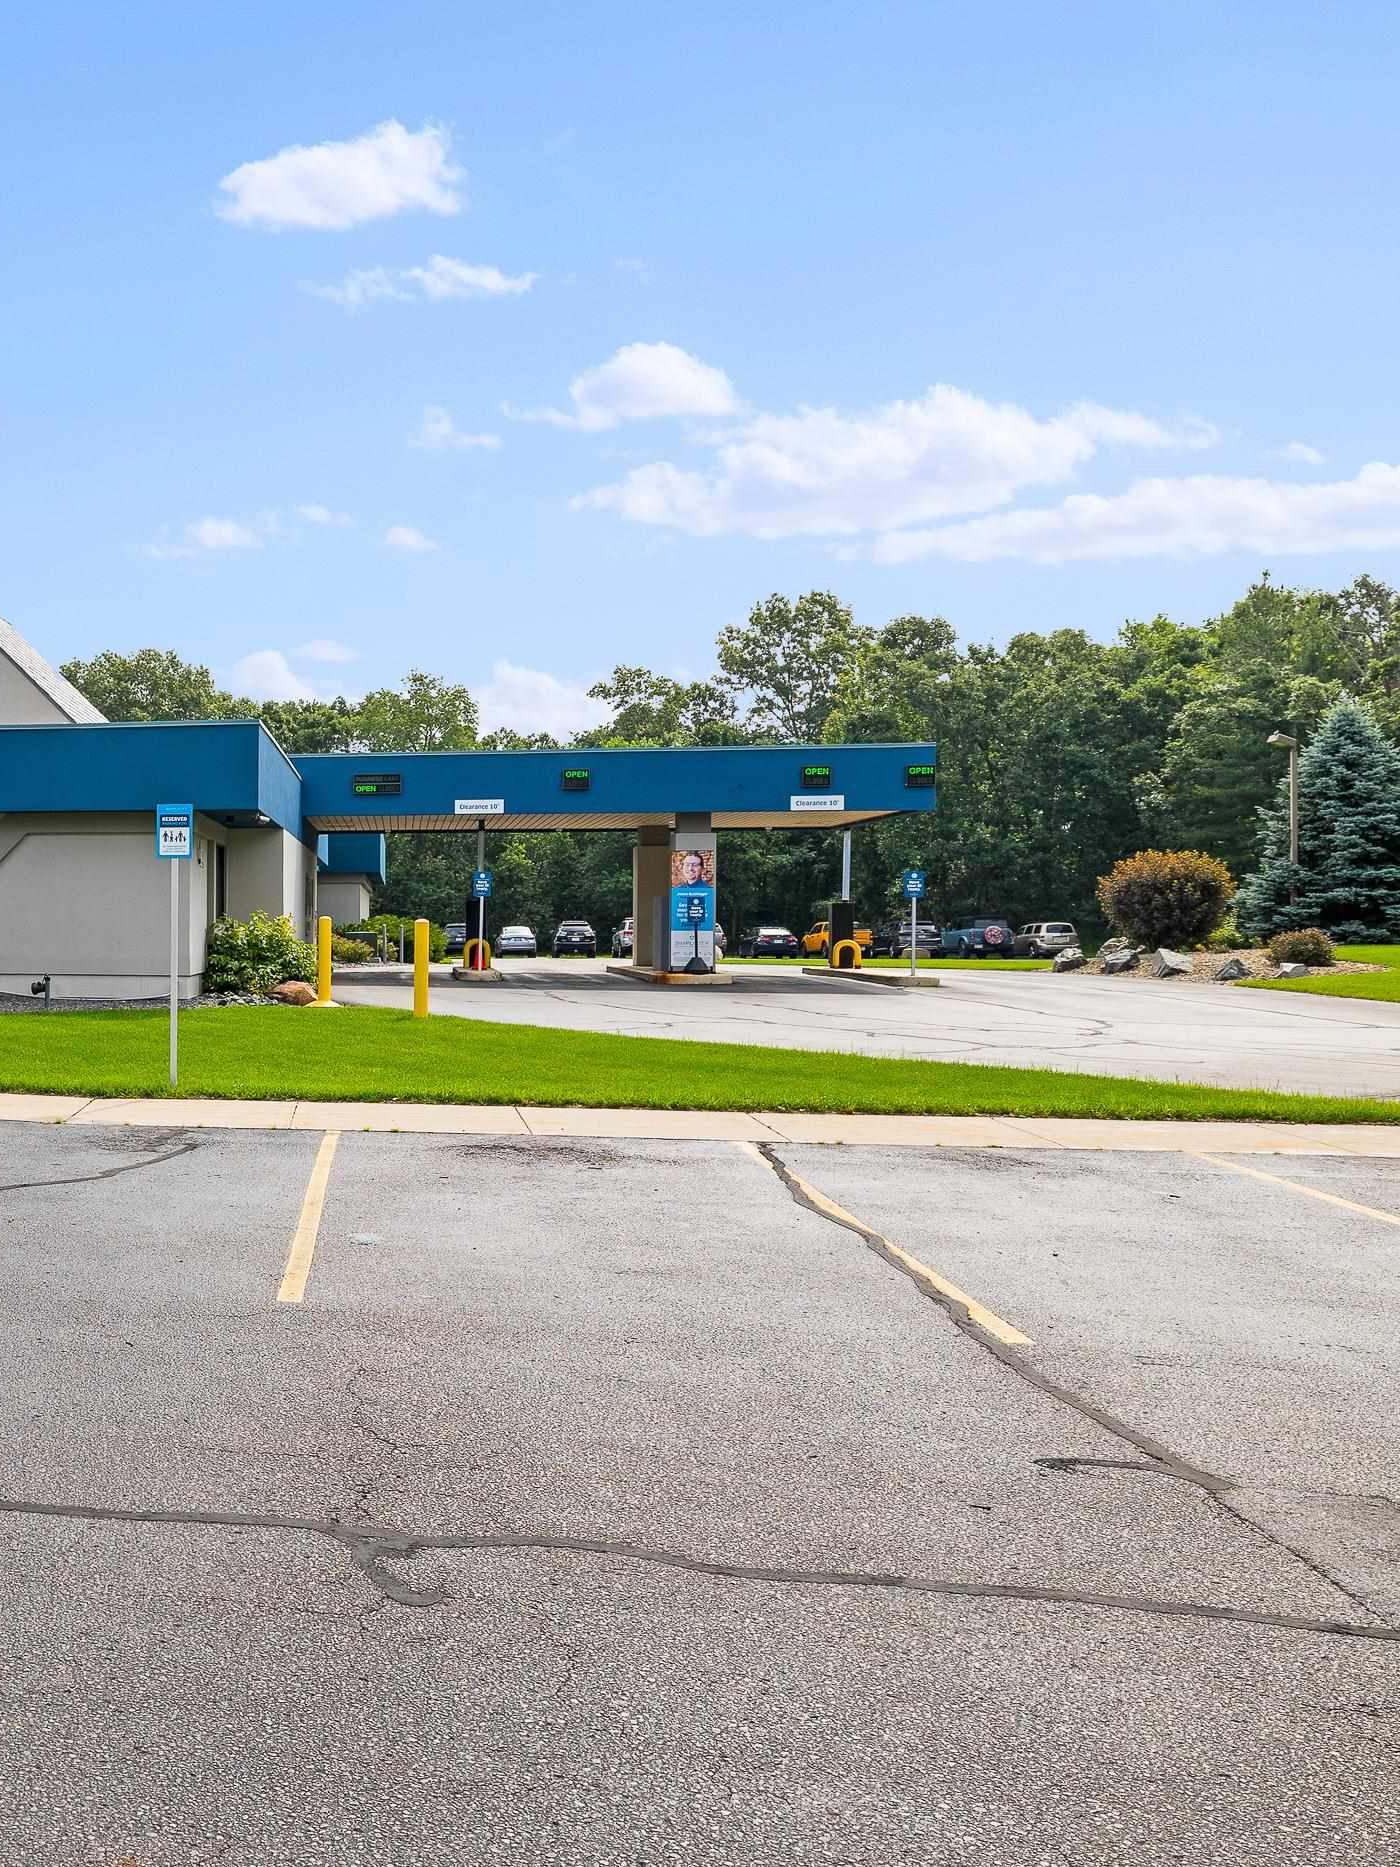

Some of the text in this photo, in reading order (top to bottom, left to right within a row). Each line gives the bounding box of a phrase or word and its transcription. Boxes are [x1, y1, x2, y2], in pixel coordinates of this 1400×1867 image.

[565, 770, 588, 778] OPEN
[805, 767, 829, 775] OPEN
[355, 785, 377, 793] OPEN
[459, 803, 489, 811] Clearance
